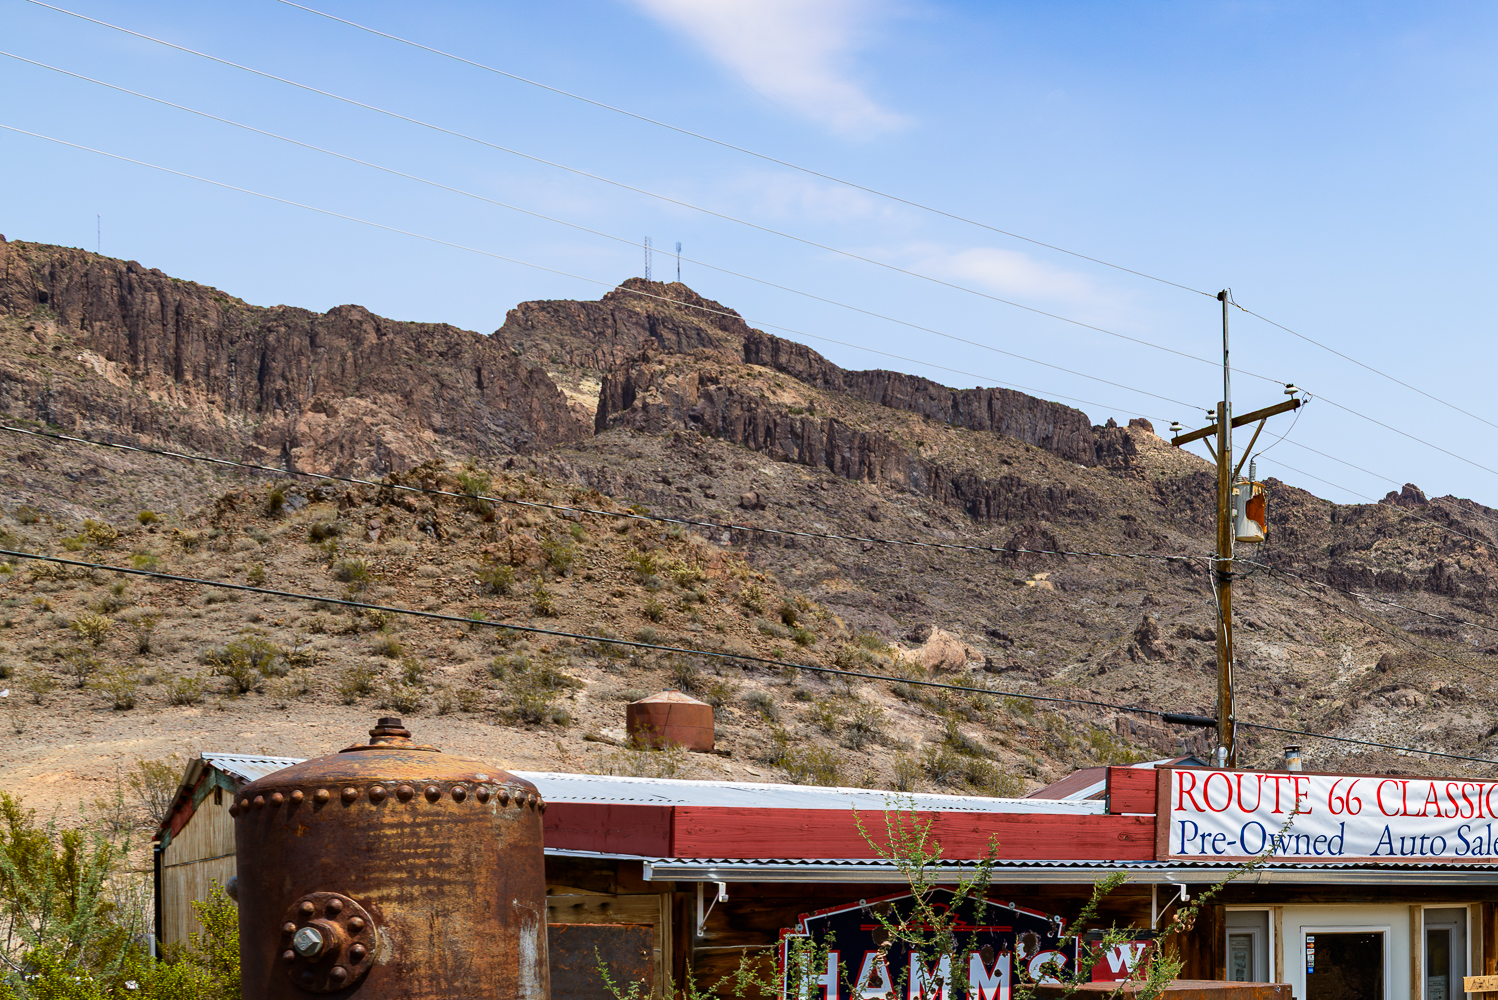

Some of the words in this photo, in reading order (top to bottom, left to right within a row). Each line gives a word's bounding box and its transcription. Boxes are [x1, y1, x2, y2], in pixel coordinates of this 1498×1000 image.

[1174, 771, 1313, 814] ROUTE
[1328, 778, 1362, 815] 66
[1177, 820, 1345, 856] Pre-Owned
[1370, 824, 1447, 856] Auto
